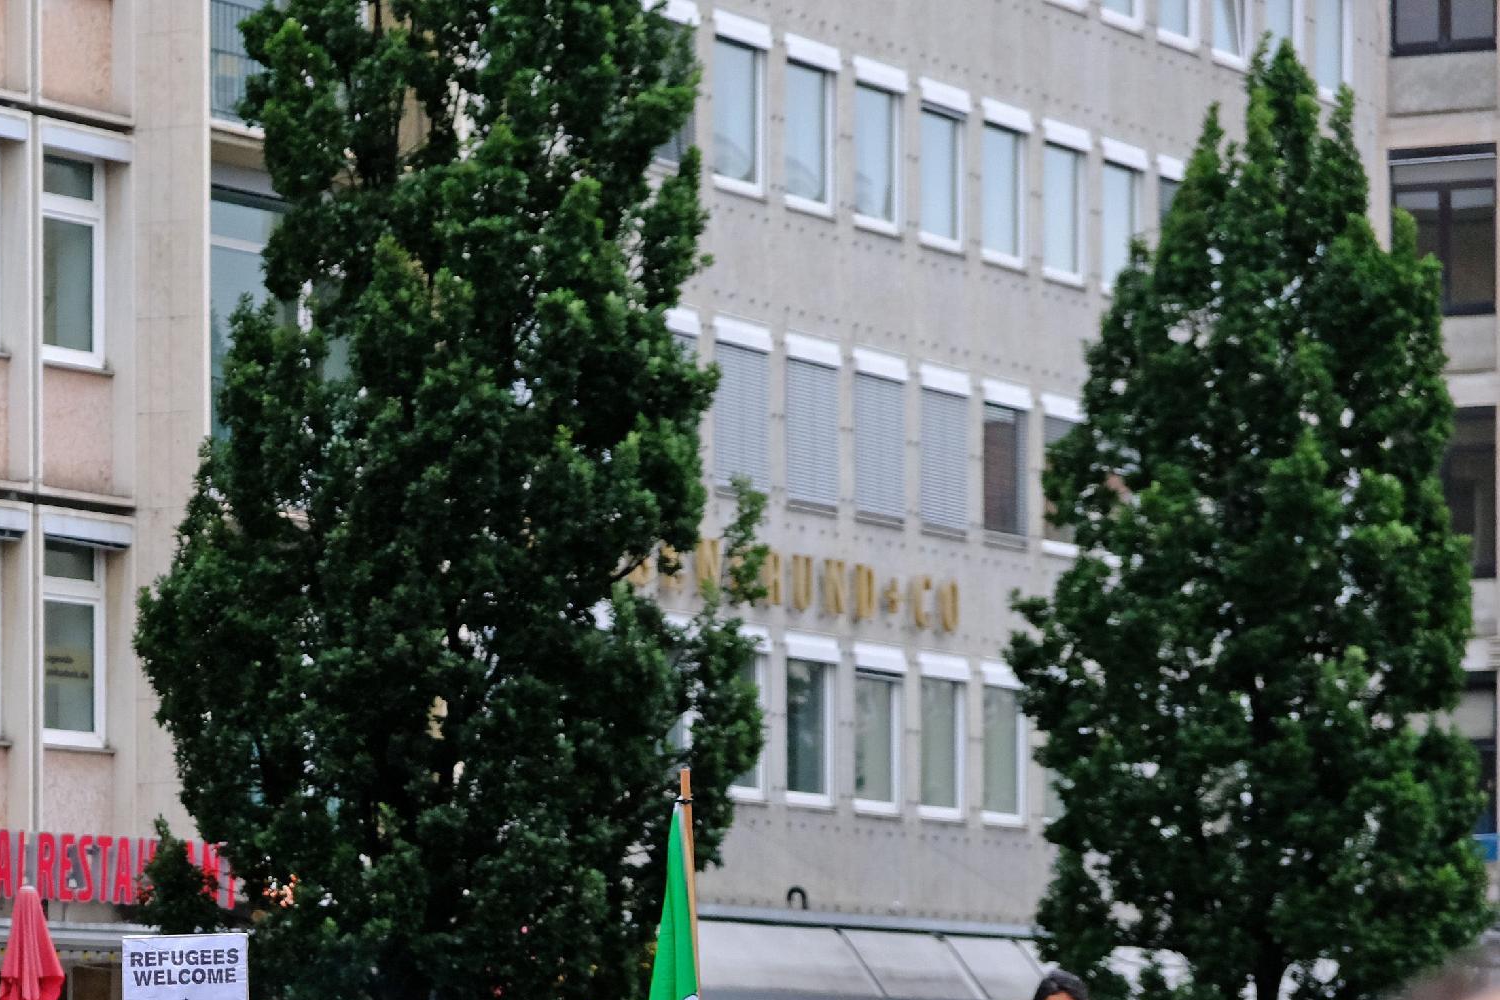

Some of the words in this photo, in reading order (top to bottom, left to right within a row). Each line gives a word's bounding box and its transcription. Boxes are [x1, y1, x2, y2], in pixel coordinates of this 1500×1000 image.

[907, 574, 959, 632] CO
[130, 948, 239, 968] REFUGEES
[133, 967, 237, 987] WELCOME
